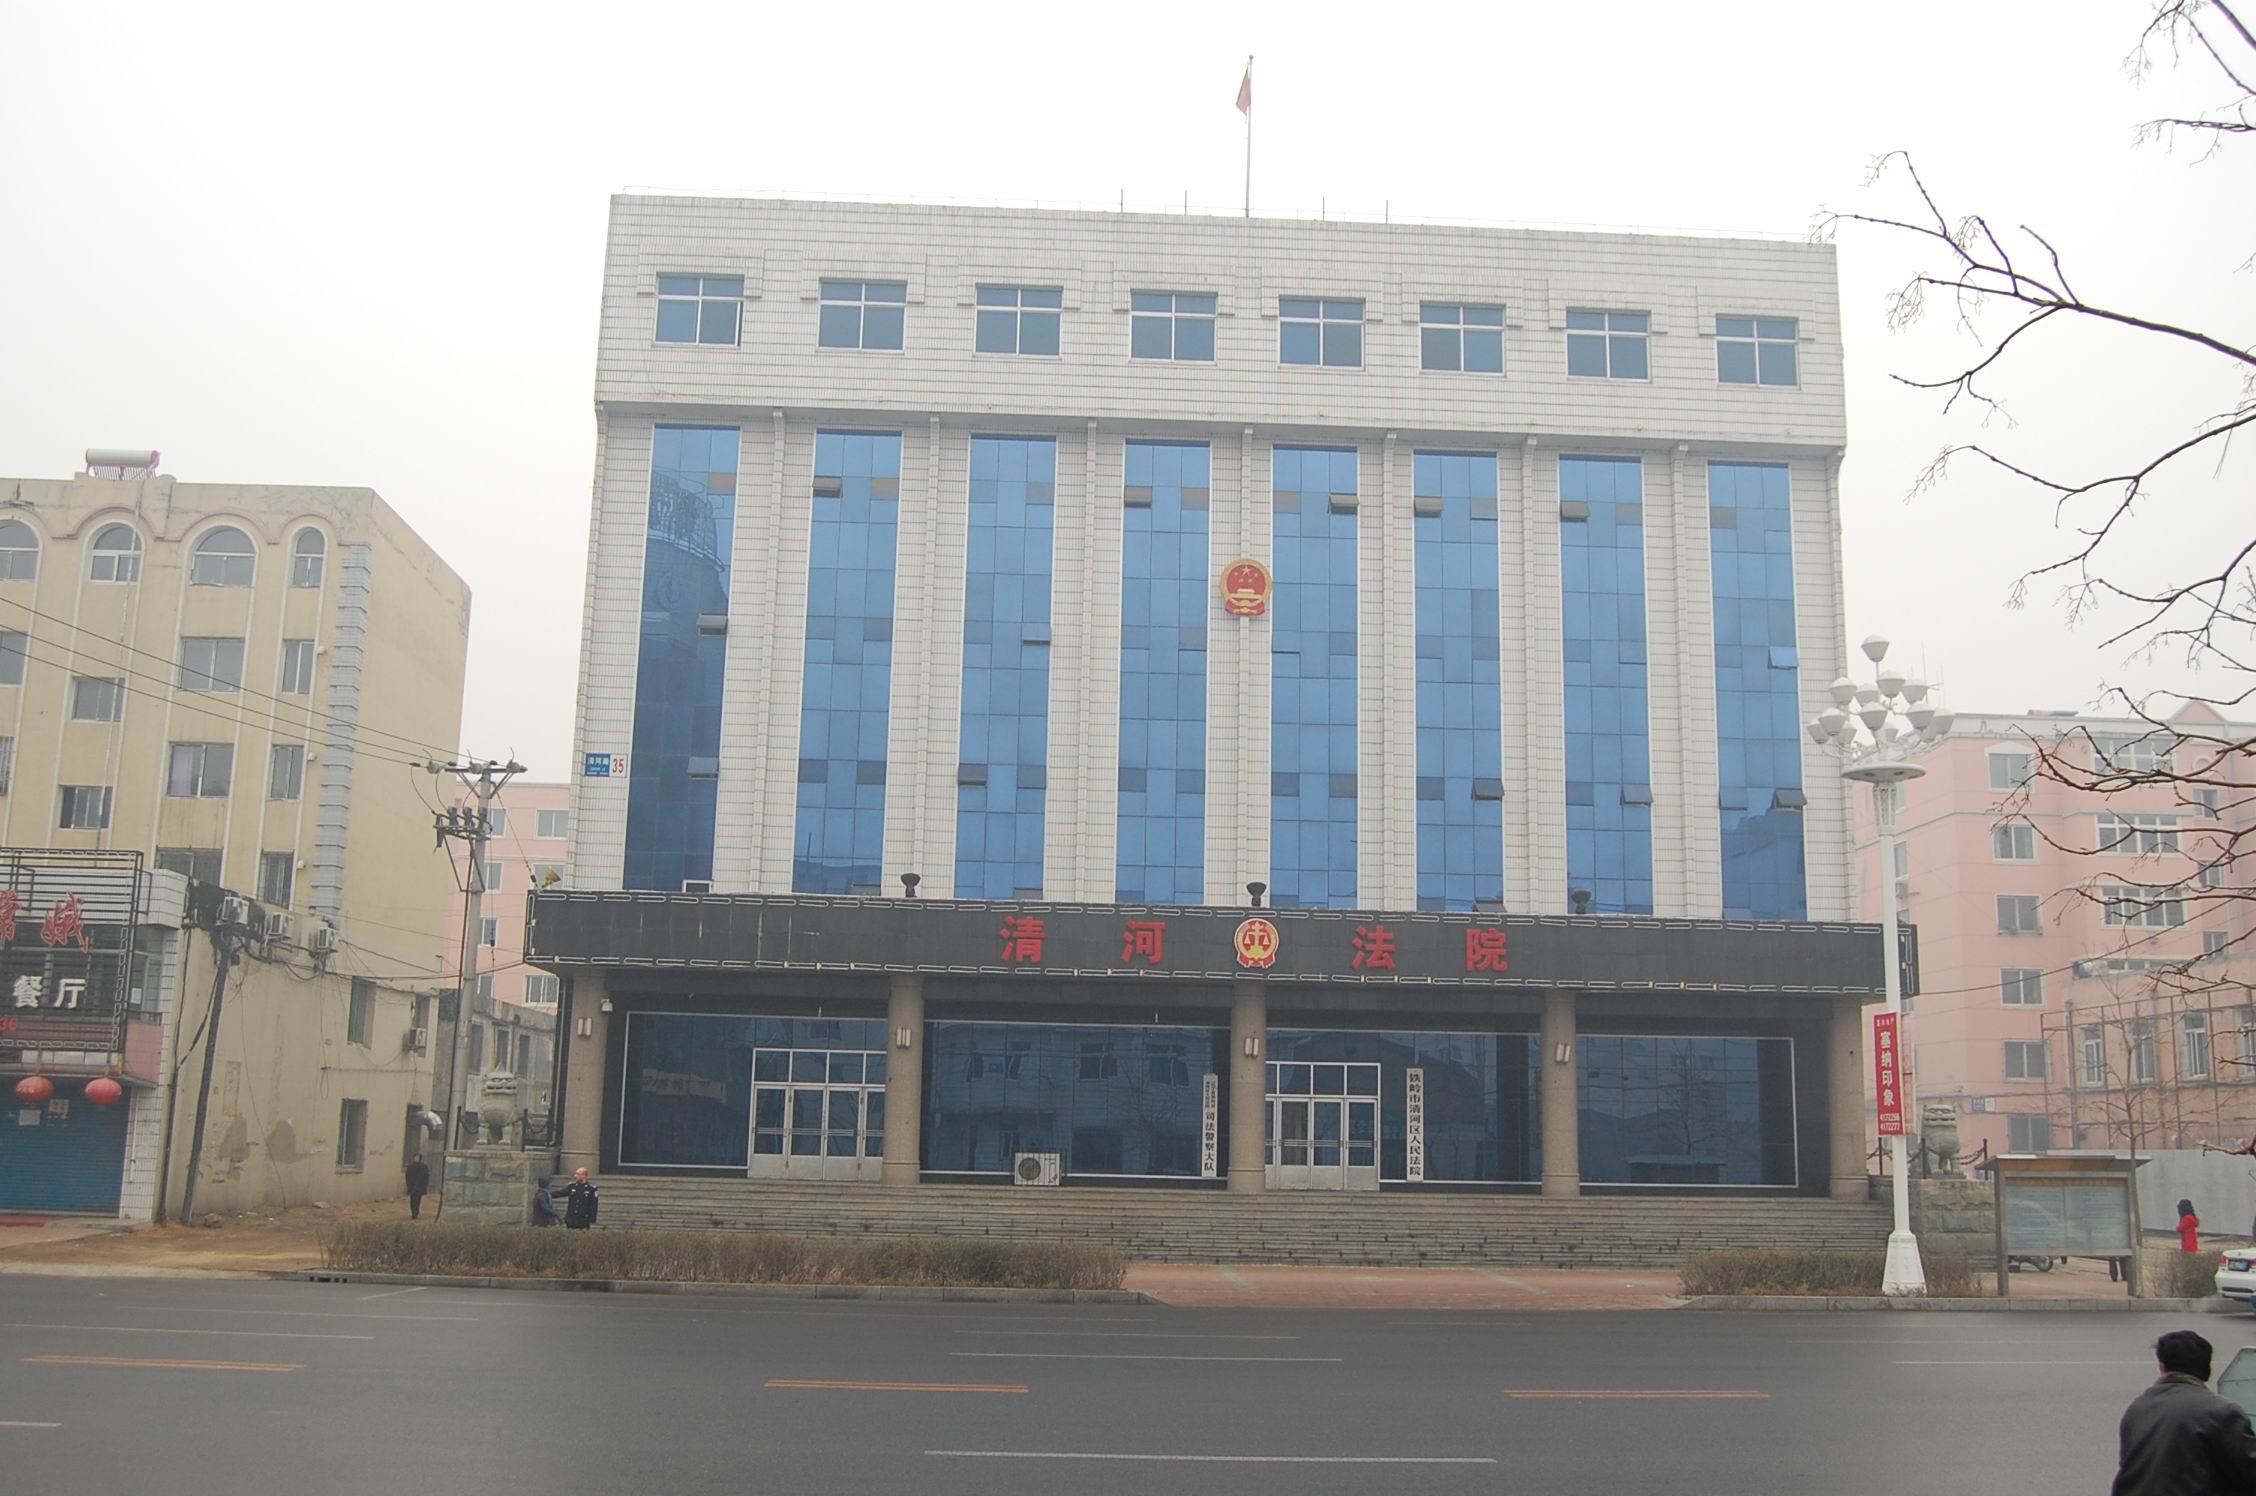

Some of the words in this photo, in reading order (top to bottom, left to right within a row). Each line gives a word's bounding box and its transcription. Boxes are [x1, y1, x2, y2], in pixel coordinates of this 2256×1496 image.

[612, 758, 624, 773] 35
[1000, 916, 1168, 965] 清河
[1352, 925, 1508, 972] 法院
[13, 975, 87, 1009] 餐厅
[1881, 1031, 1894, 1106] 塞纳印象
[1204, 1112, 1215, 1172] 司法警察大队
[1409, 1073, 1421, 1176] 铁岭市清河区人民法院
